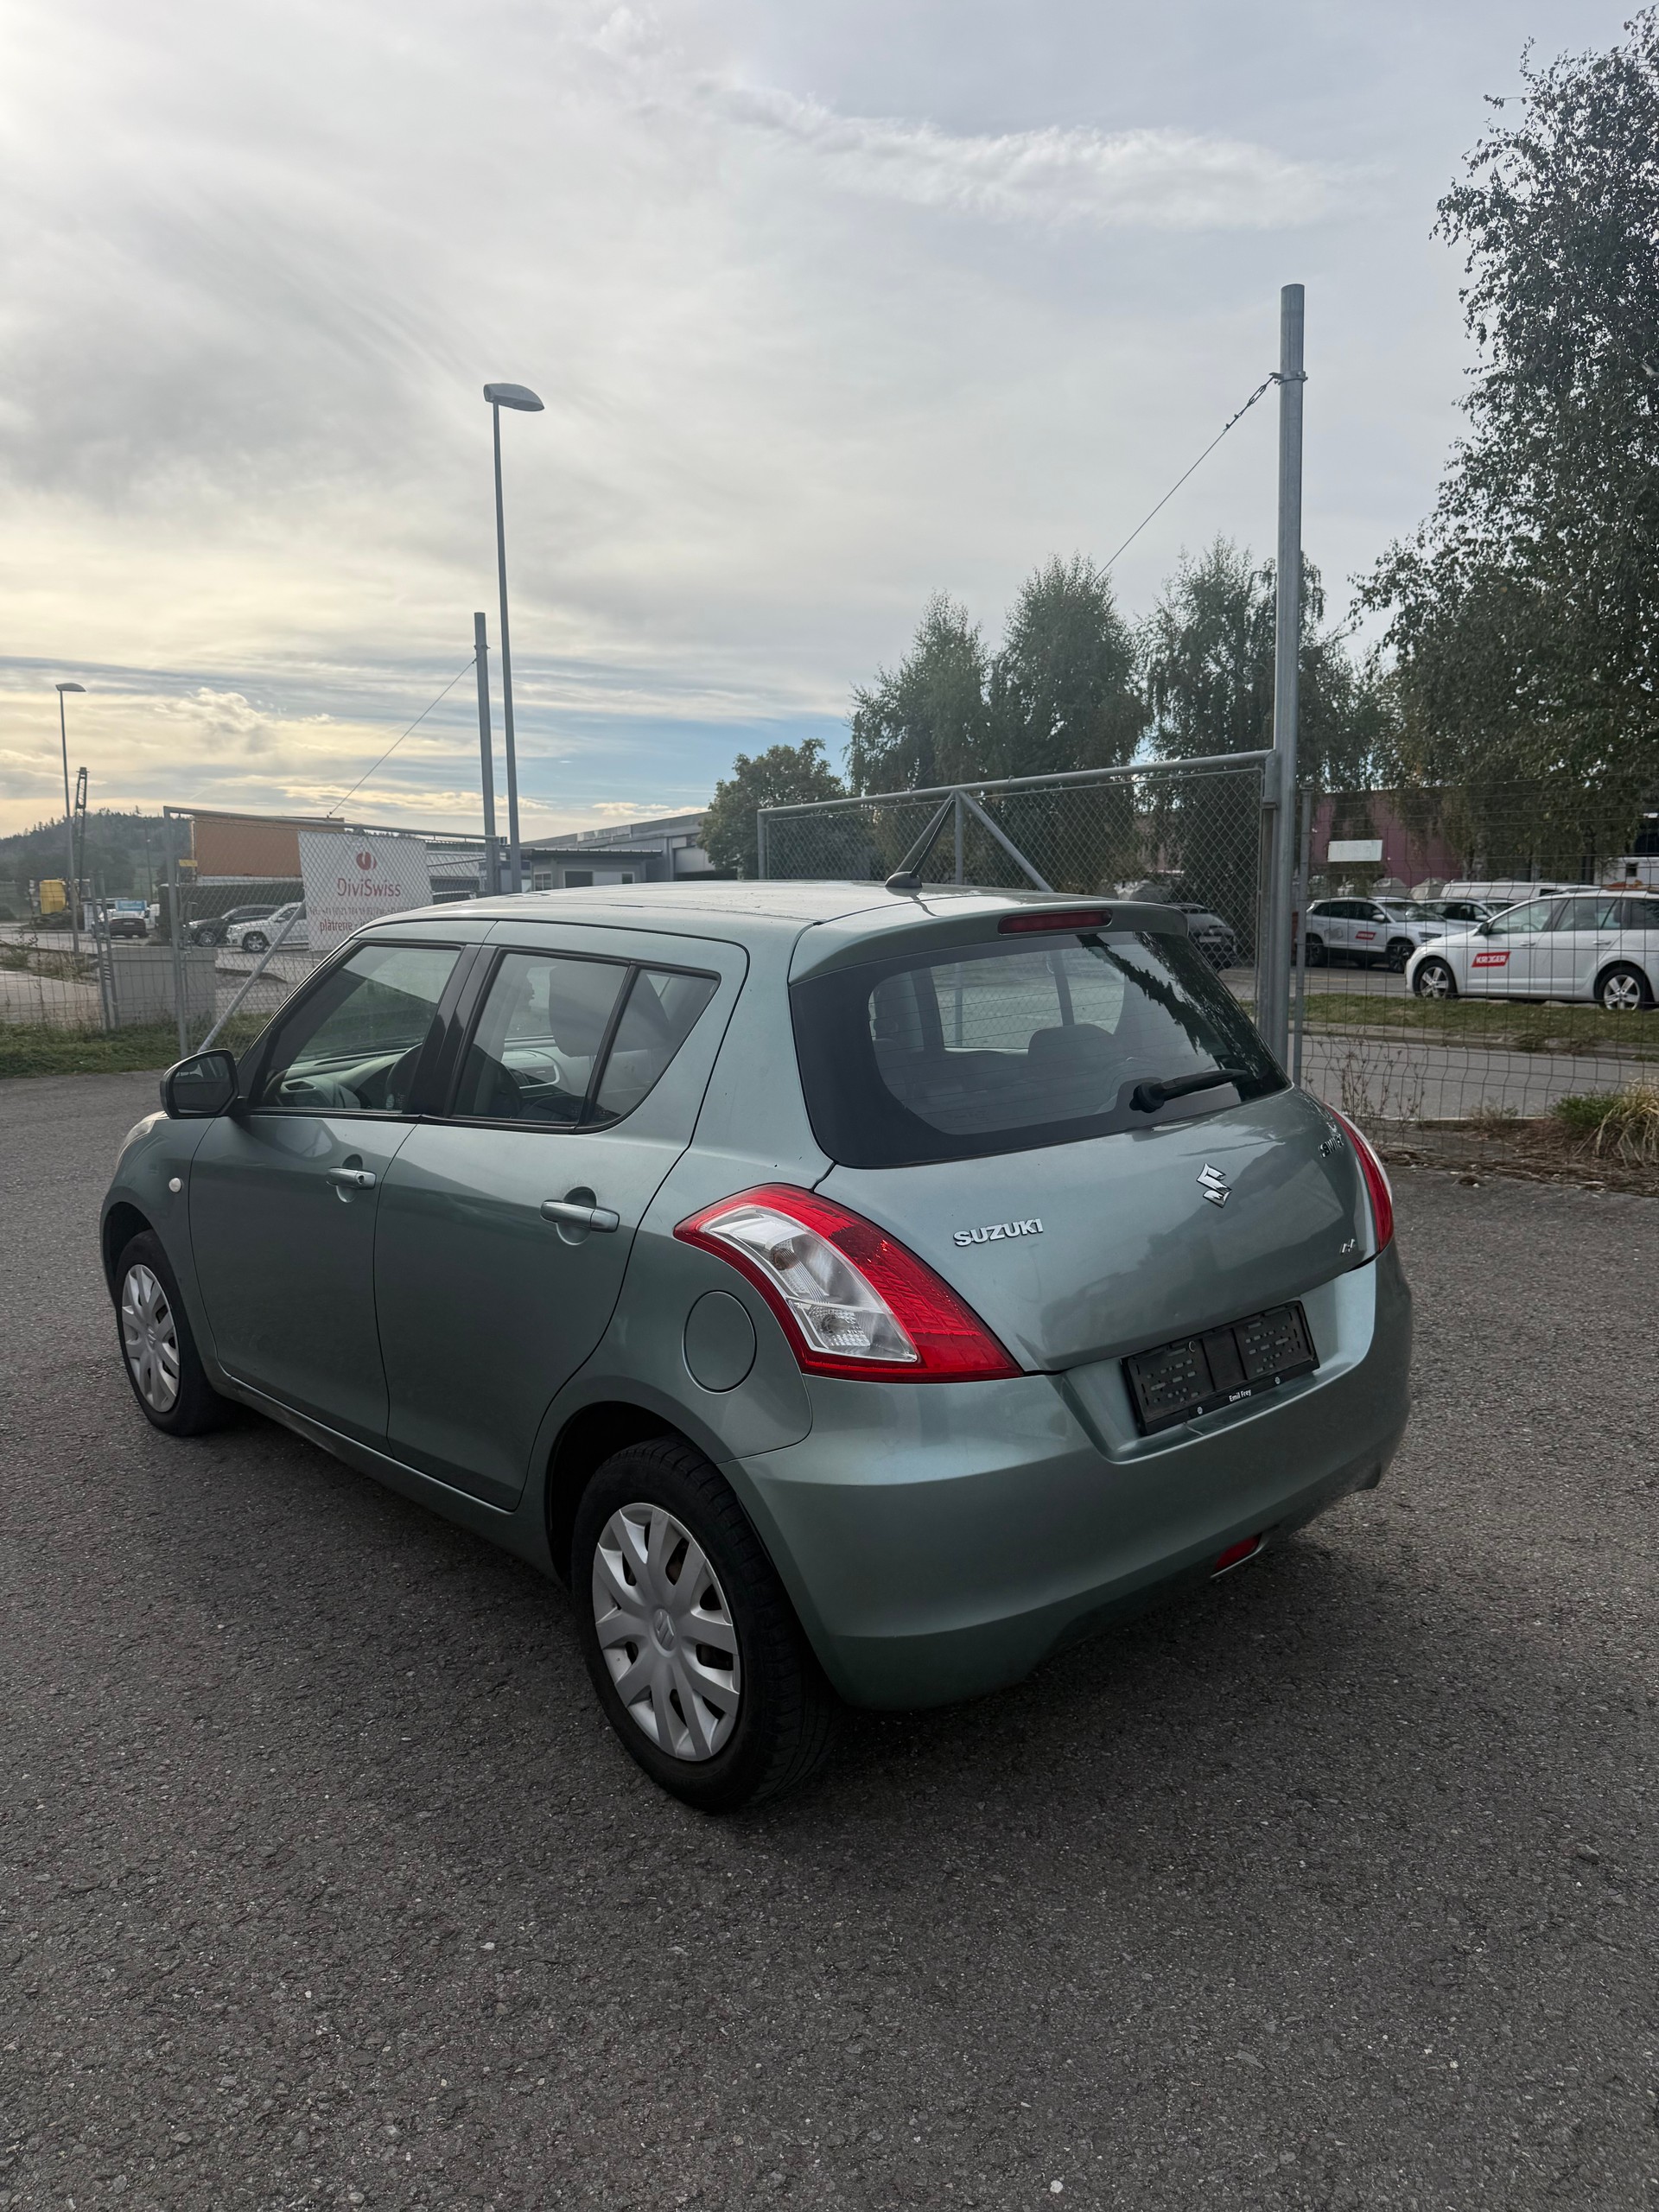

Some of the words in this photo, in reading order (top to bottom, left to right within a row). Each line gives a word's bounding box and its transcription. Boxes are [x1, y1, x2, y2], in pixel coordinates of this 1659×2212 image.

[337, 878, 401, 897] DiviSwiss
[953, 1218, 1043, 1247] SUZUKI
[1229, 1392, 1241, 1402] Emil
